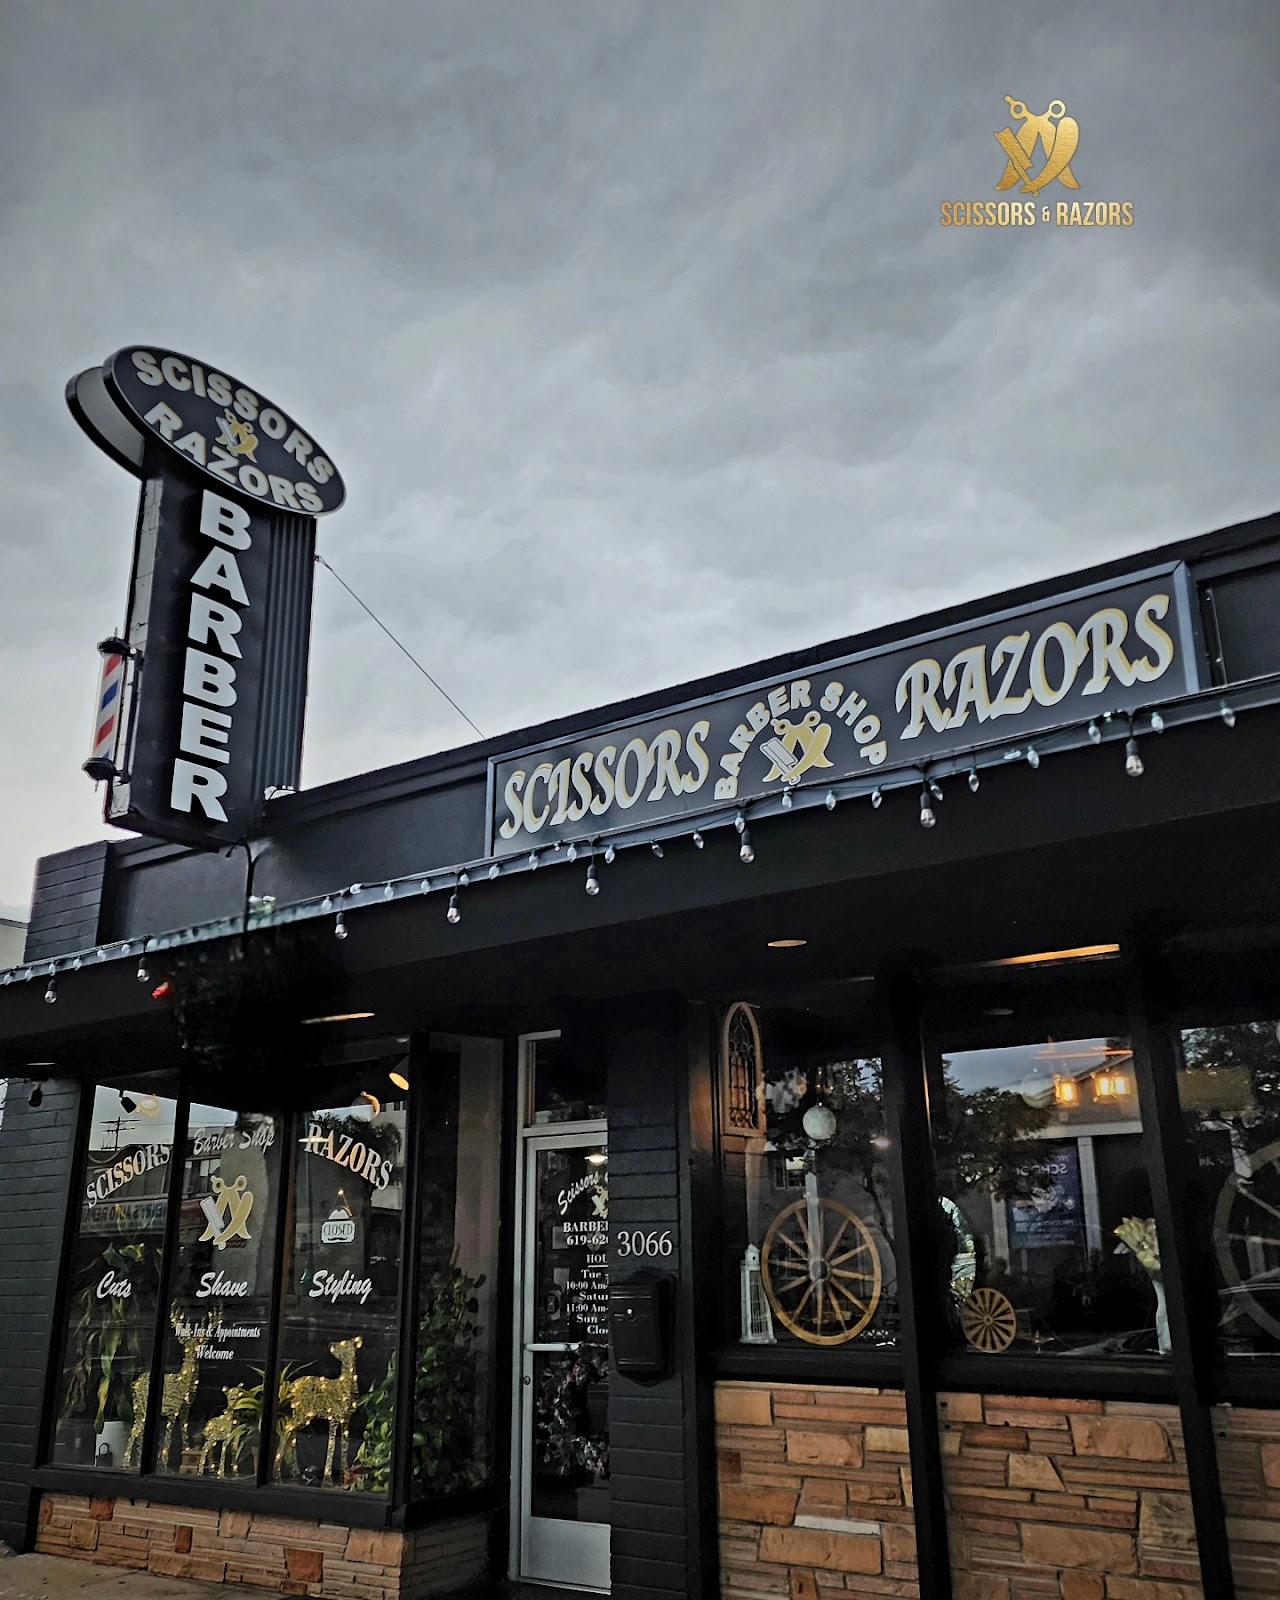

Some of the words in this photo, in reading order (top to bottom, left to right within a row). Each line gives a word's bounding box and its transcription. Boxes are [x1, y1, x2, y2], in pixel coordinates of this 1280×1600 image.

[131, 350, 335, 485] SCISSORS
[143, 401, 325, 513] RAZORS
[170, 488, 252, 823] BARBER
[895, 594, 1175, 741] RAZORS
[713, 679, 812, 801] BARBER
[819, 681, 888, 766] SHOP
[498, 719, 712, 840] SCISSORS
[193, 1127, 235, 1156] Barber
[239, 1124, 275, 1154] Shop
[303, 1122, 395, 1191] RAZORS
[86, 1138, 171, 1210] SCISSORS
[557, 1171, 599, 1216] Scissors
[323, 1223, 353, 1237] CLOSED
[563, 1220, 609, 1233] BARBE
[566, 1233, 609, 1246] 619-62
[617, 1230, 673, 1257] 3066
[586, 1253, 608, 1264] HOU
[96, 1270, 132, 1299] Cuts
[196, 1270, 249, 1298] Shave
[308, 1269, 373, 1305] Styling
[581, 1269, 602, 1279] Tue
[580, 1291, 609, 1301] Satu
[576, 1313, 598, 1324] Sun
[586, 1324, 609, 1335] Clo
[214, 1323, 261, 1343] Appointments
[196, 1345, 235, 1360] Welcome
